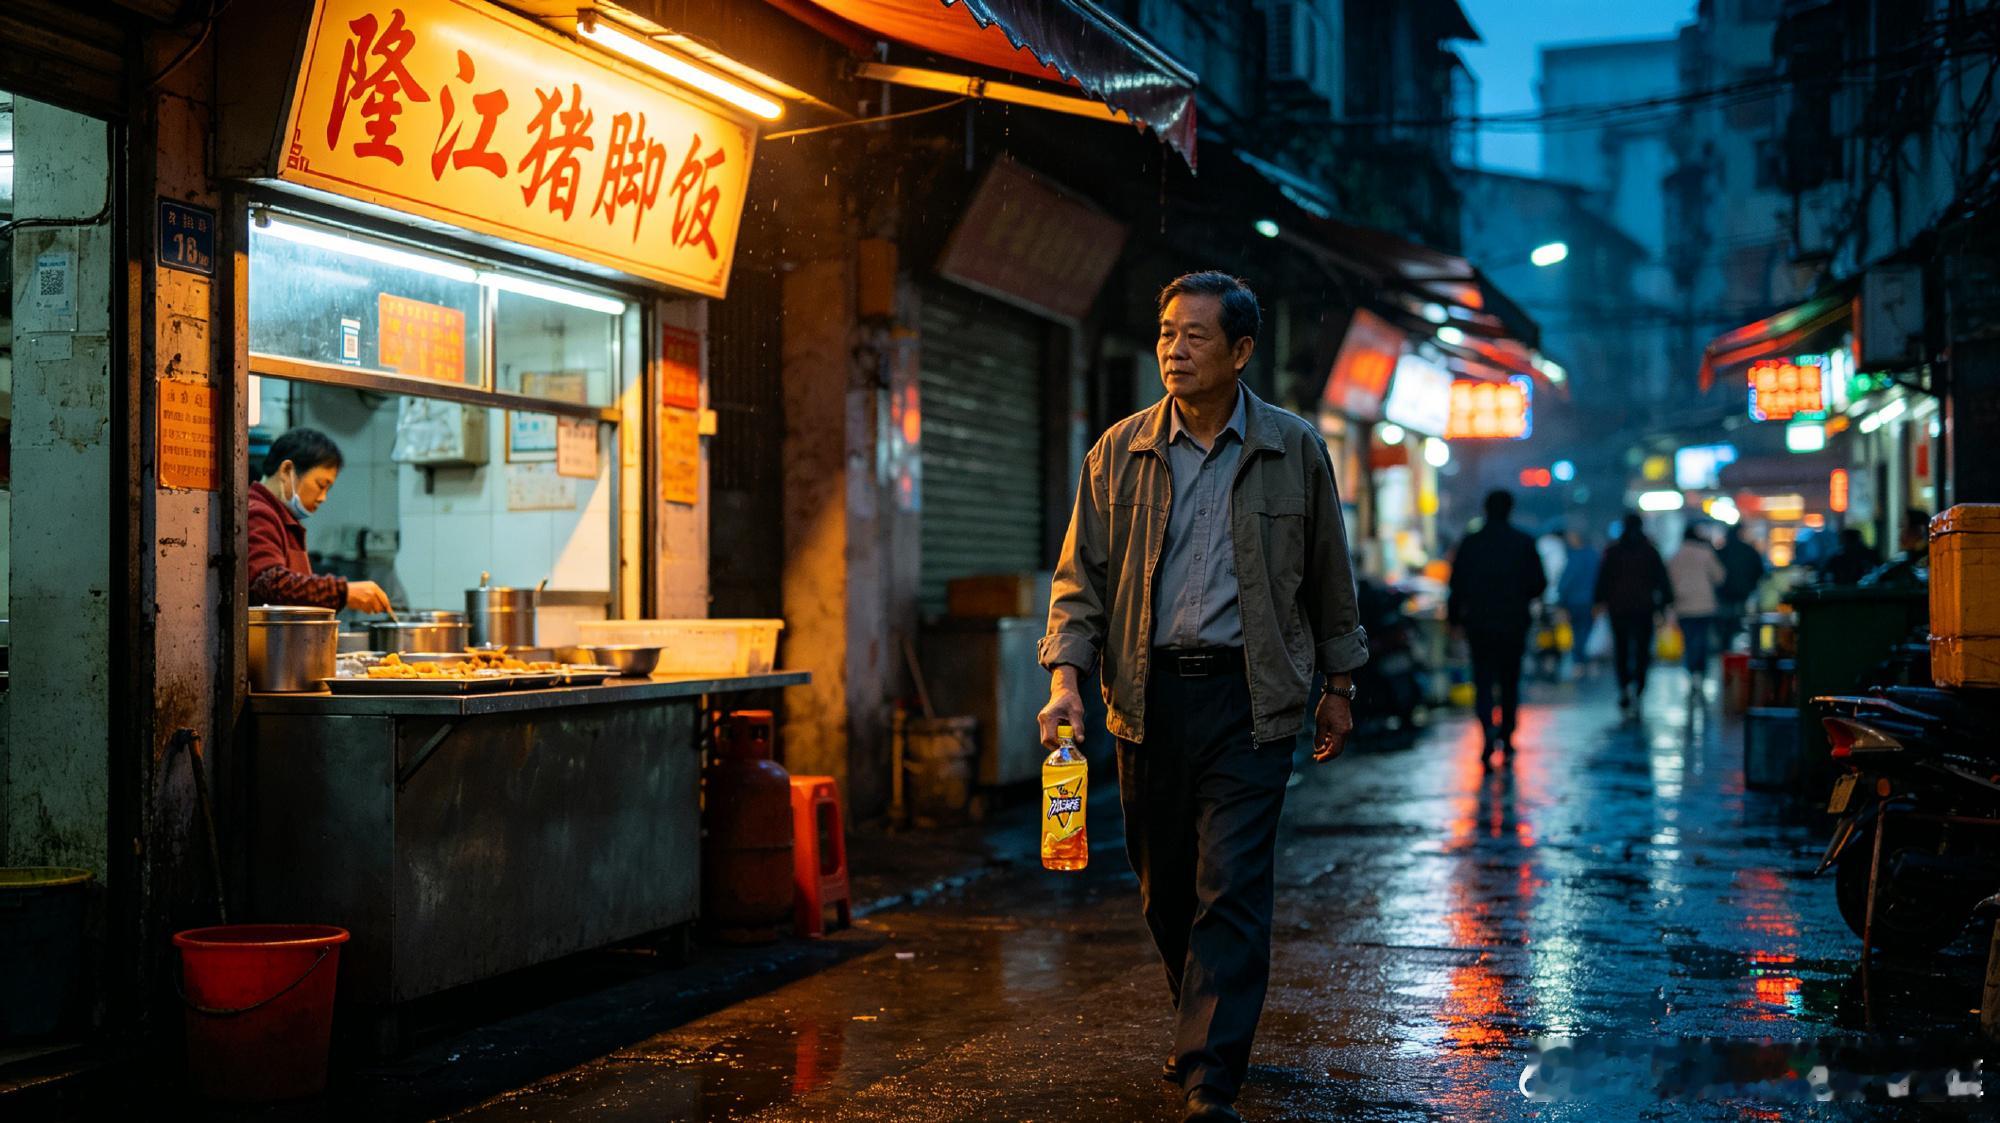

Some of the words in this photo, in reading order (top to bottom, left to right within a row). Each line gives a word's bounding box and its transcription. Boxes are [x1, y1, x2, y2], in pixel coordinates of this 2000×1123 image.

[326, 8, 726, 260] 隆江猪脚饭
